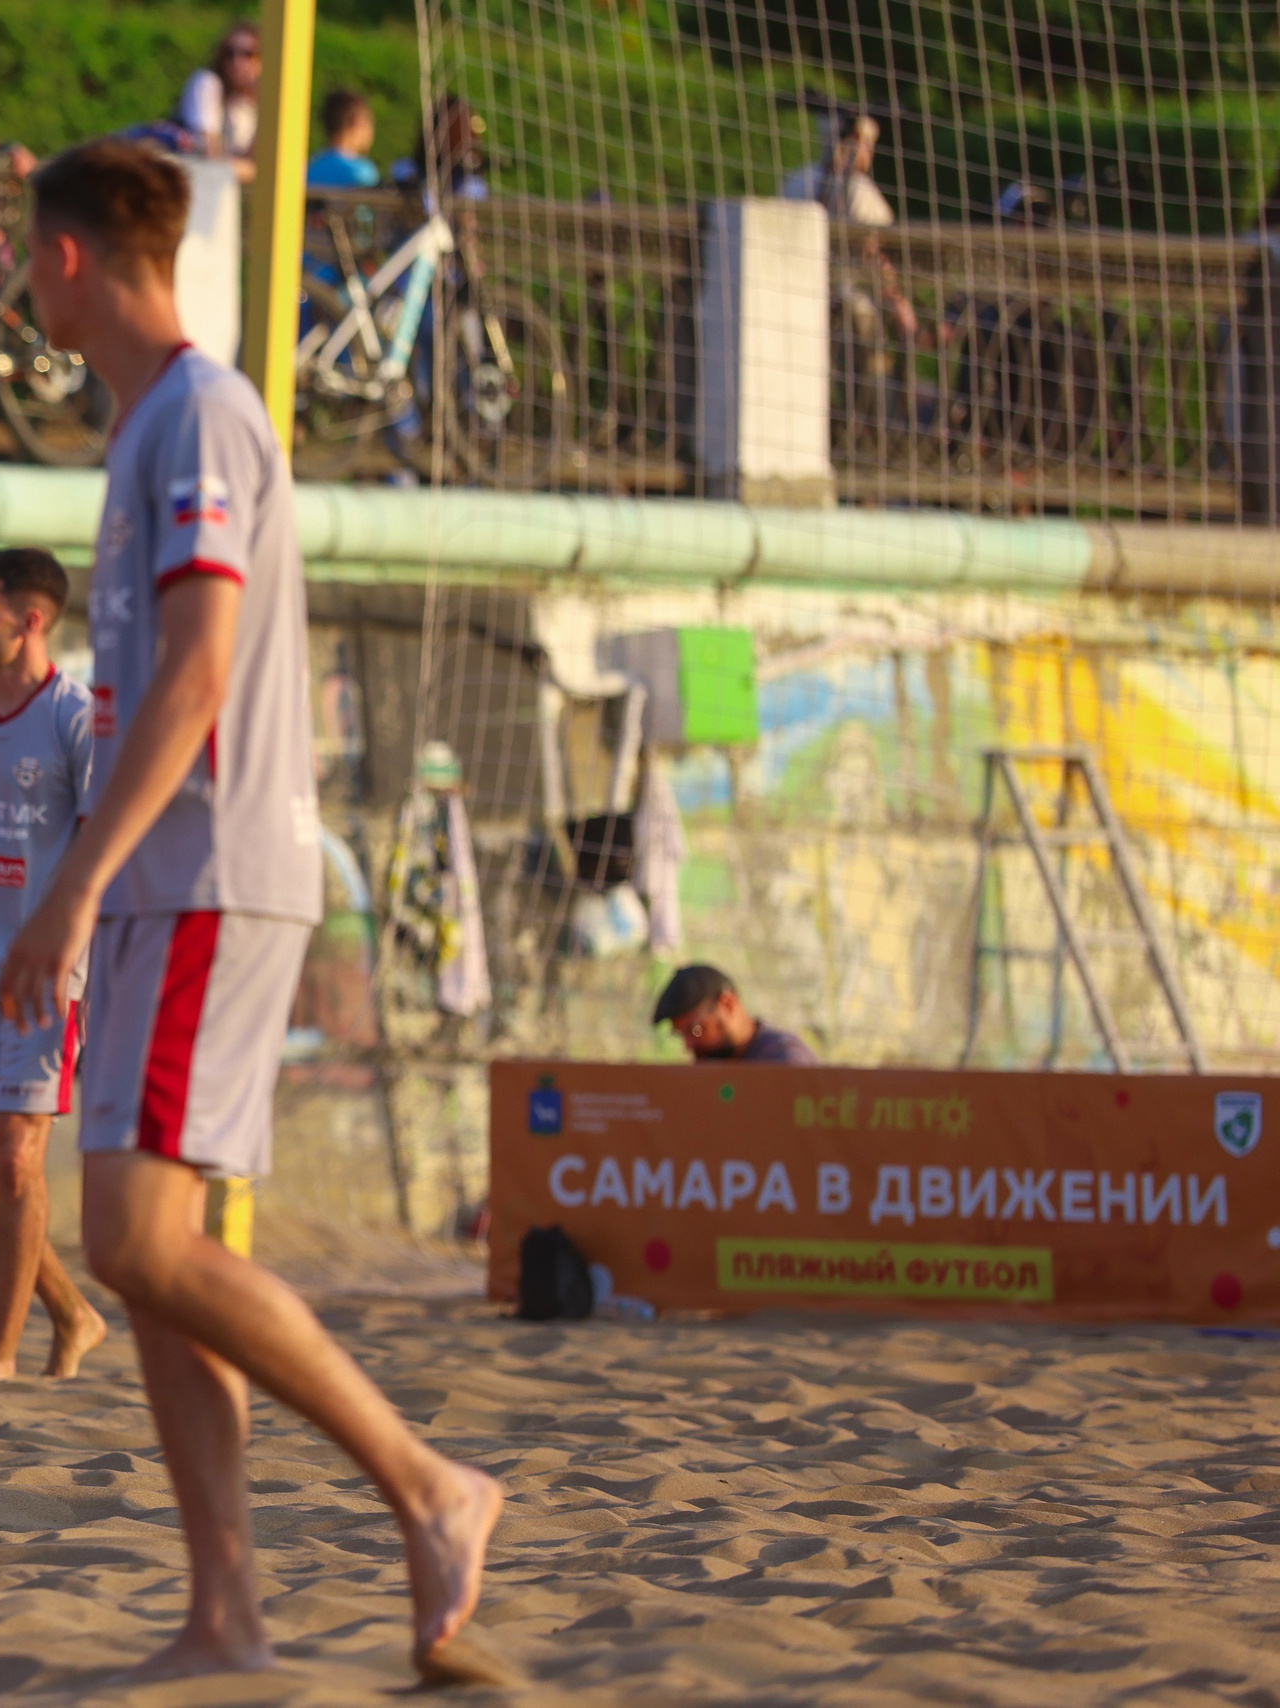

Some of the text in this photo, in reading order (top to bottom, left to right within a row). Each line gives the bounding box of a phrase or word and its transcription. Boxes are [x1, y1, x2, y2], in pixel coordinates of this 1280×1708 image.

[548, 1155, 1228, 1227] САМАРА В ДВИЖЕНИИ
[732, 1249, 1040, 1291] ПЛЯЖНЫЙ ФУТБОЛ
